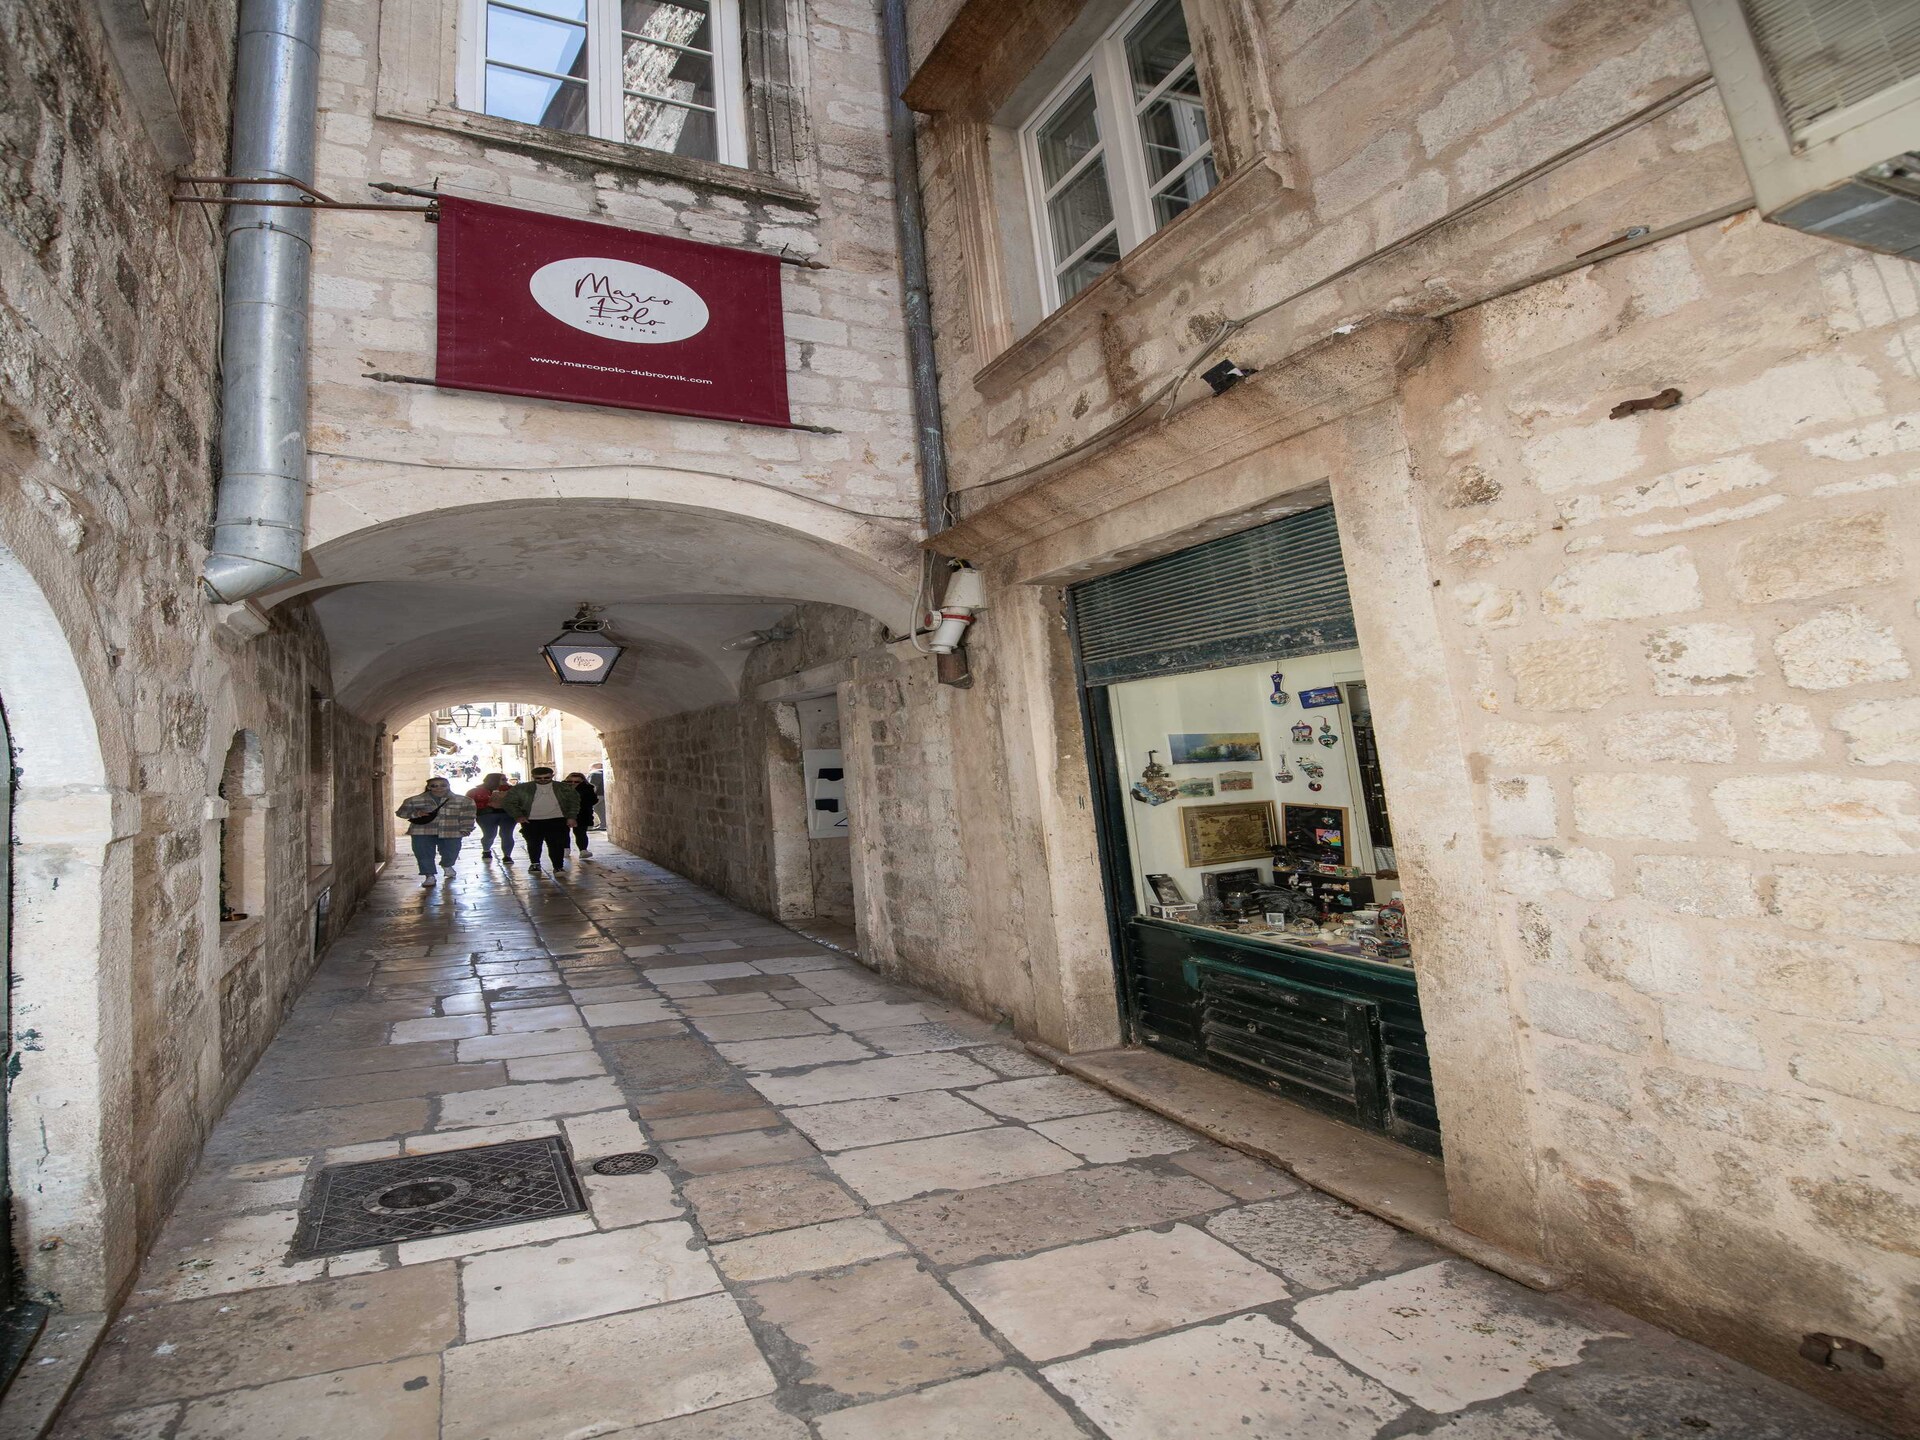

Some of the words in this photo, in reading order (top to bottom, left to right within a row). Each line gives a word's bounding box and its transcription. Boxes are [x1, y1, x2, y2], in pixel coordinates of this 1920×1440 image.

[575, 272, 673, 306] Marco
[587, 295, 666, 326] Polo
[586, 320, 658, 335] CUISINE
[530, 356, 713, 385] www.marcopolo-dubrovnik.com
